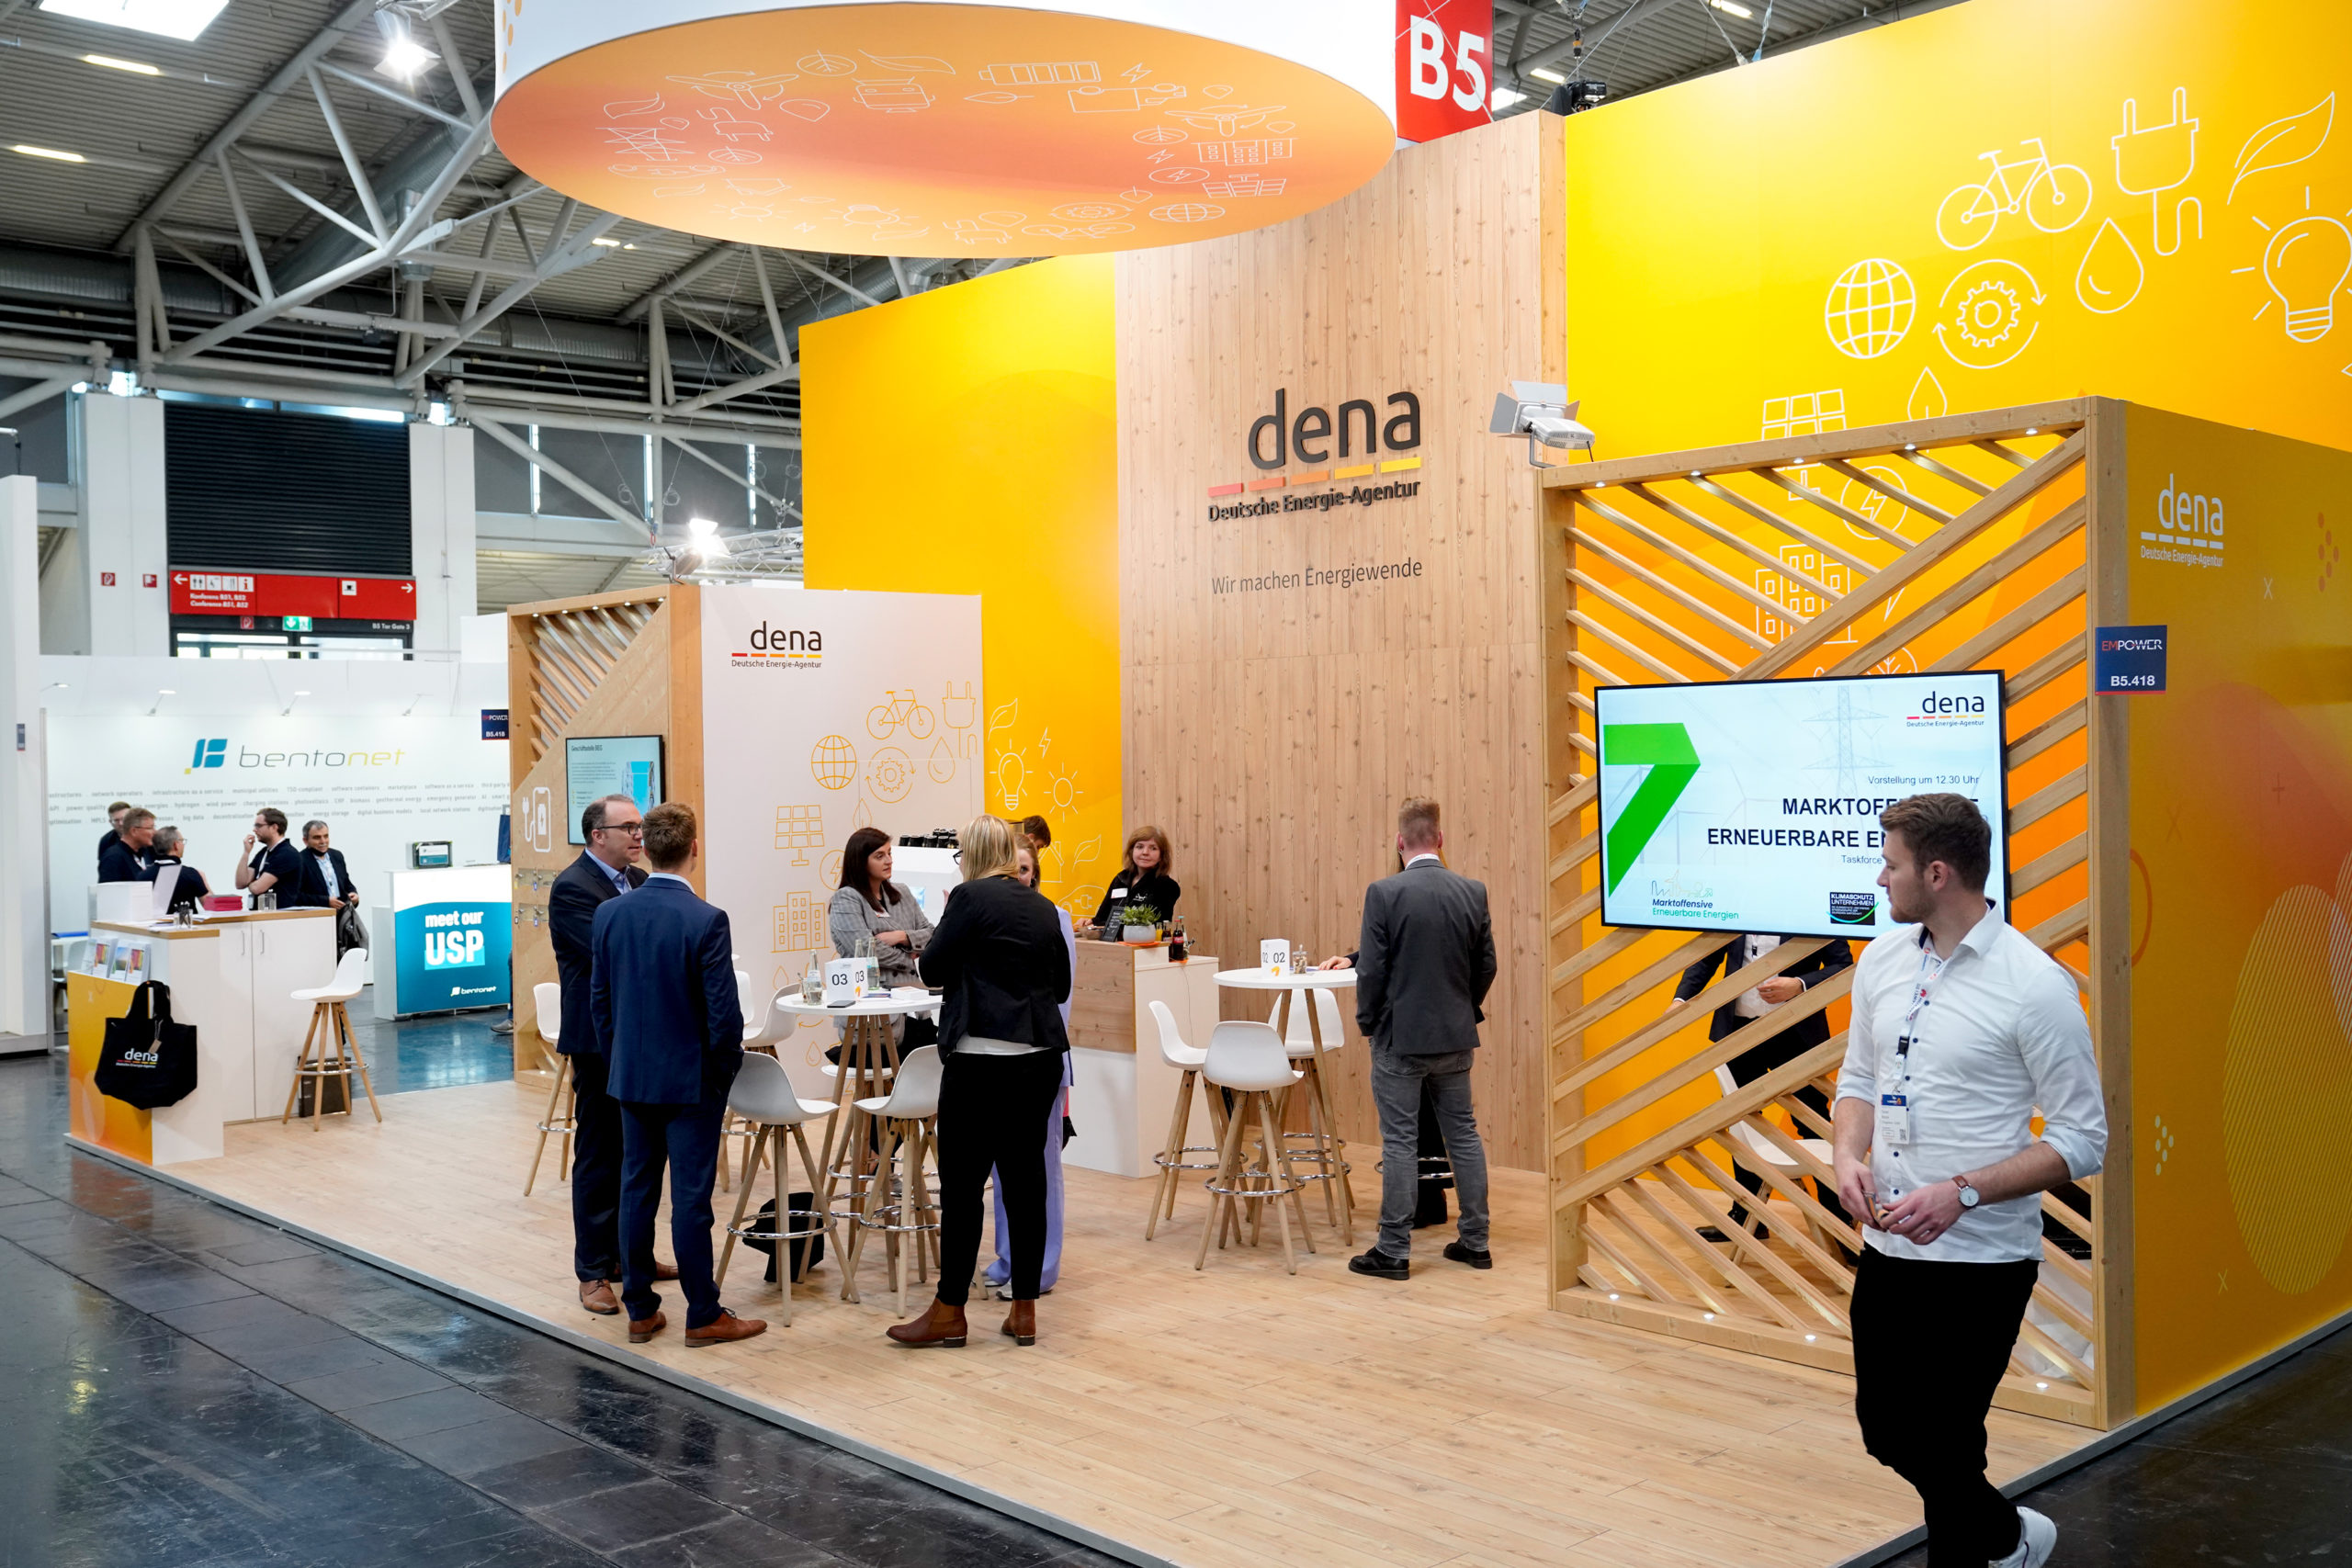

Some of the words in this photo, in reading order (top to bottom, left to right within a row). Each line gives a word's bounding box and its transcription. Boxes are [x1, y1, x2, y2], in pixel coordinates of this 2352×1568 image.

[1410, 15, 1487, 112] B5
[1248, 388, 1421, 470] dena
[1207, 496, 1278, 522] Deutsche
[1283, 480, 1421, 512] Energie-Agentur
[2158, 472, 2223, 536] dena
[2141, 545, 2171, 561] Deutsche
[2172, 548, 2223, 568] Energie-Agentur
[1212, 575, 1237, 595] Wir
[1240, 570, 1300, 592] machen
[1306, 557, 1422, 588] Energiewende
[751, 620, 822, 651] dena
[2102, 638, 2163, 650] EMPOWER
[731, 660, 764, 668] Deutsche
[765, 660, 822, 669] Energie-Agentur
[2110, 675, 2155, 687] B5.418
[1922, 691, 1984, 714] dena
[239, 745, 405, 768] bentonet
[1868, 776, 1917, 786] Vorstellung
[1936, 775, 1961, 784] 12.30
[1962, 775, 1980, 784] Uhr
[1708, 829, 1860, 848] ERNEUERBARE
[1841, 854, 1883, 864] Taskforce
[1653, 898, 1713, 908] Marktoffensive
[1831, 894, 1873, 902] KLIMASCHUTZ
[424, 910, 460, 928] meet
[461, 911, 484, 925] our
[1653, 908, 1702, 917] Erneuerbare
[1703, 909, 1739, 921] Energien
[424, 930, 484, 965] USP
[1272, 952, 1285, 964] 02
[831, 974, 848, 986] 03
[854, 970, 865, 983] 03
[460, 986, 497, 995] bentonet
[124, 1047, 159, 1062] dena
